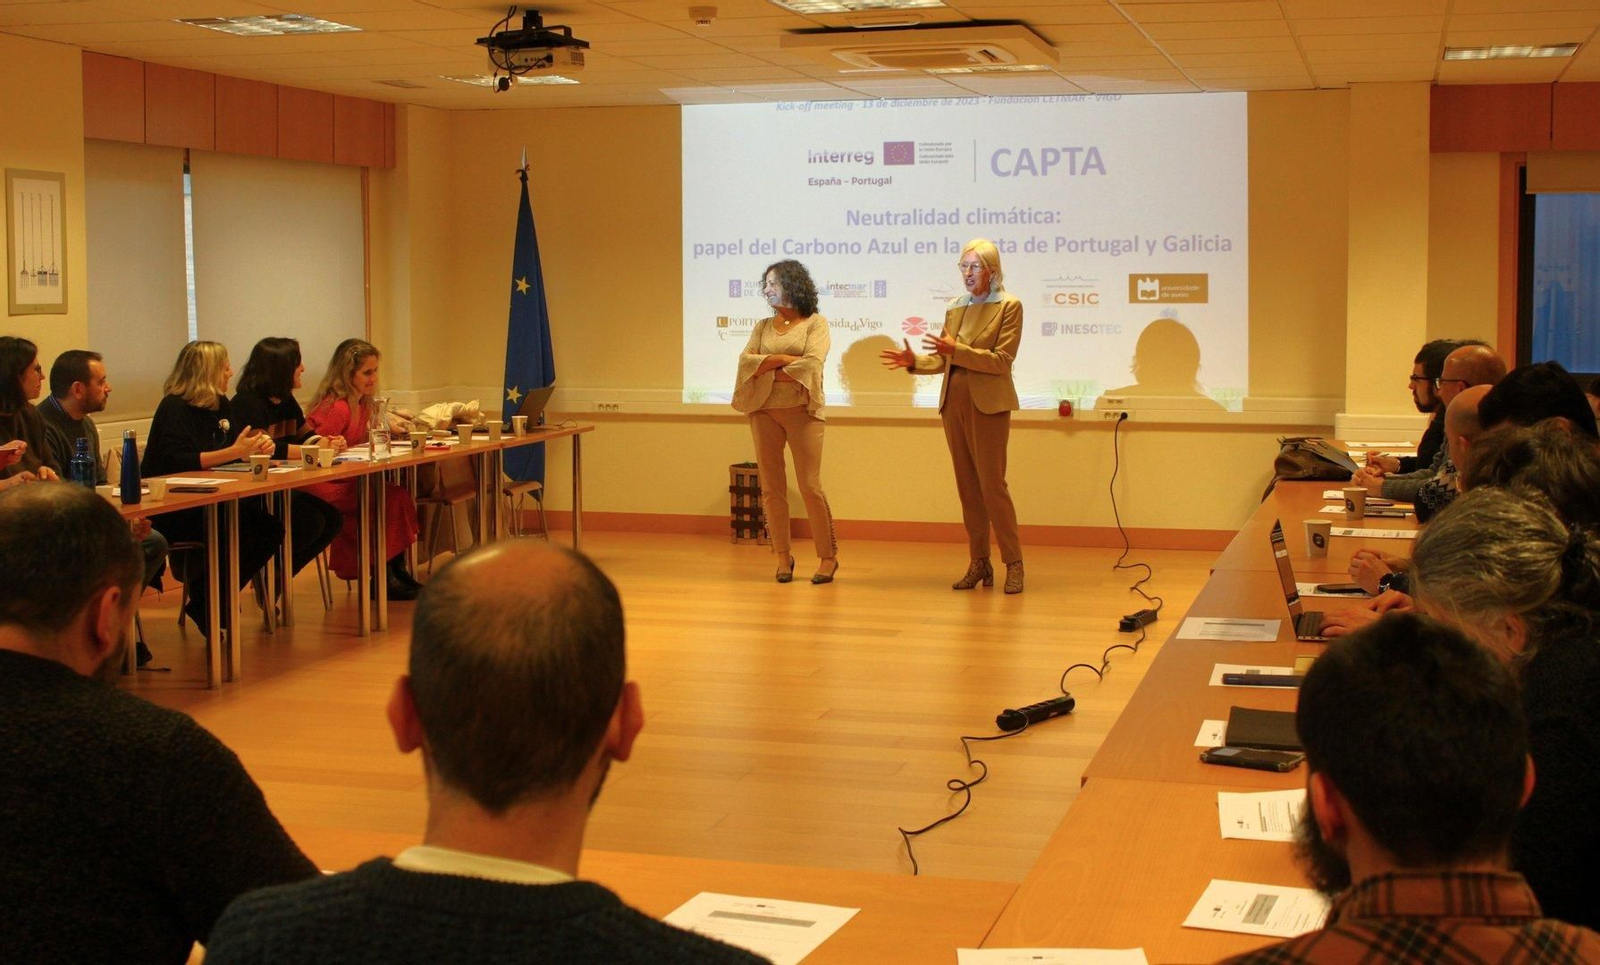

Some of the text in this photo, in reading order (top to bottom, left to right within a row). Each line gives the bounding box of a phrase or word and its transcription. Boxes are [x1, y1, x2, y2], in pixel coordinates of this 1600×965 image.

[776, 101, 811, 111] Kick-off
[814, 100, 854, 111] meeting
[862, 100, 873, 109] 13
[877, 99, 888, 108] de
[890, 98, 938, 108] diciembre
[941, 98, 953, 106] de
[956, 97, 979, 106] 2023
[808, 149, 874, 165] Interreg
[990, 146, 1107, 177] CAPTA
[808, 176, 842, 187] España
[851, 176, 892, 187] Portugal
[846, 206, 1062, 226] Neutralidad climática:
[693, 239, 743, 259] papel
[748, 238, 777, 256] del
[782, 238, 862, 255] Carbono
[867, 237, 908, 254] Azul
[914, 240, 938, 255] en
[944, 237, 960, 254] la
[1024, 236, 1048, 253] de
[1054, 234, 1139, 257] Portugal
[1145, 239, 1157, 257] y
[1163, 233, 1232, 252] Galicia
[1054, 292, 1099, 305] CSIC
